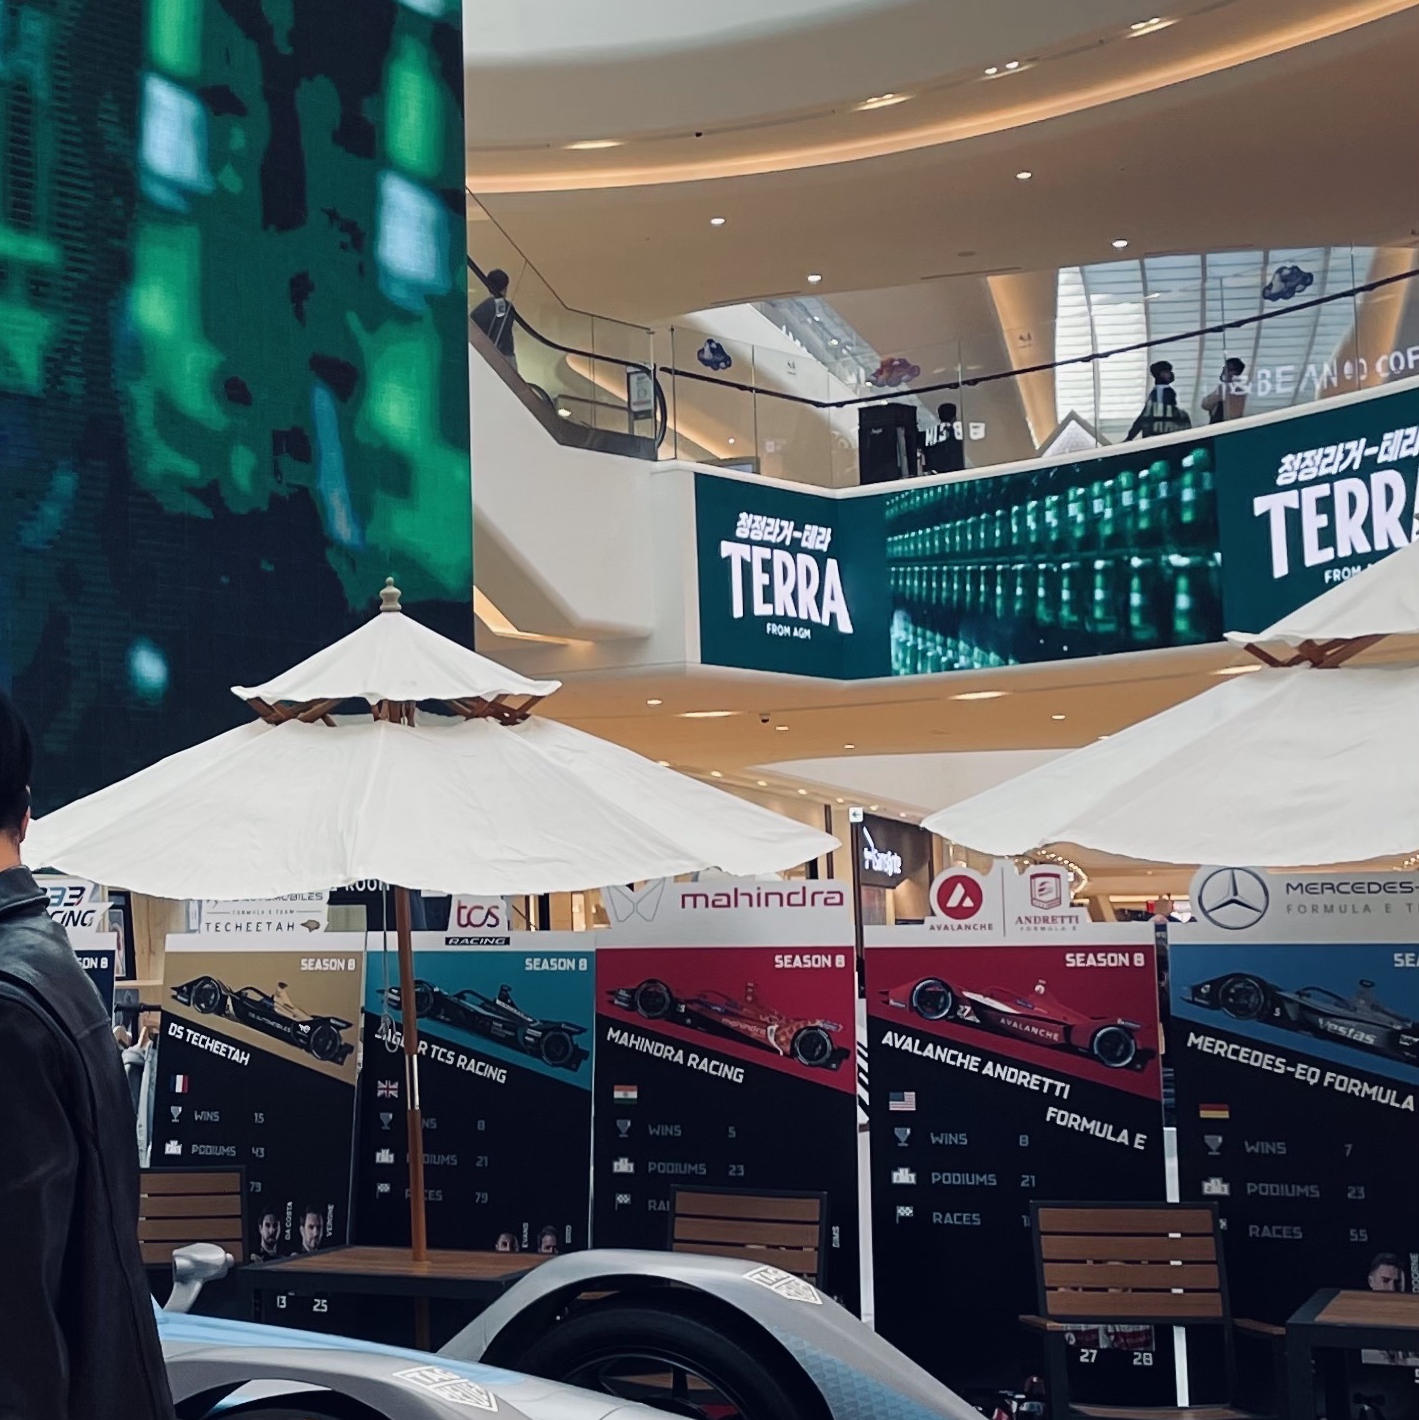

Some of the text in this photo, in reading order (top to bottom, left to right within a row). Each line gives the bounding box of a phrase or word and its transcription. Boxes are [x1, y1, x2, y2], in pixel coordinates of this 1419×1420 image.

[1253, 468, 1419, 579] TERR
[720, 540, 854, 634] TERRA
[766, 622, 812, 640] FROM AGM
[681, 886, 844, 909] mahindra
[1287, 903, 1393, 914] FORMULA E
[205, 922, 296, 933] TECHEETAH
[929, 923, 994, 932] AVALANCHE
[1015, 915, 1079, 925] ANDRETTI
[448, 937, 507, 945] RACING
[300, 958, 356, 971] SEASON 8
[524, 957, 588, 971] SEASON 8
[774, 954, 846, 968] SEASON 8
[1065, 953, 1145, 967] SEASON 8
[999, 1017, 1060, 1042] AVALANCHE
[1318, 1017, 1378, 1046] Vestas
[168, 1022, 250, 1066] DS TECHEETAH
[606, 1026, 744, 1084] MAHINDRA RACING
[431, 1044, 456, 1066] TCS
[456, 1052, 508, 1085] RACING
[881, 1030, 1071, 1100] AVALANCHE ANDRETTI
[1186, 1032, 1416, 1112] MERCEDES-EQ FORMULA
[194, 1110, 265, 1124] WINS 15
[648, 1124, 682, 1136] WINS
[1045, 1106, 1148, 1151] FORMULA E
[930, 1132, 968, 1146] WINS
[191, 1144, 266, 1158] PODIUMS 43
[1244, 1140, 1287, 1155] WINS
[475, 1155, 489, 1168] 21
[648, 1161, 745, 1177] PODIUMS 23
[931, 1172, 1036, 1187] PODIUMS 21
[405, 1189, 443, 1202] RCES
[1246, 1182, 1366, 1200] PODIUMS 23
[933, 1212, 981, 1226] RACES
[1248, 1225, 1369, 1242] RACES 55
[313, 1298, 328, 1313] 25
[1080, 1348, 1153, 1367] 27 28
